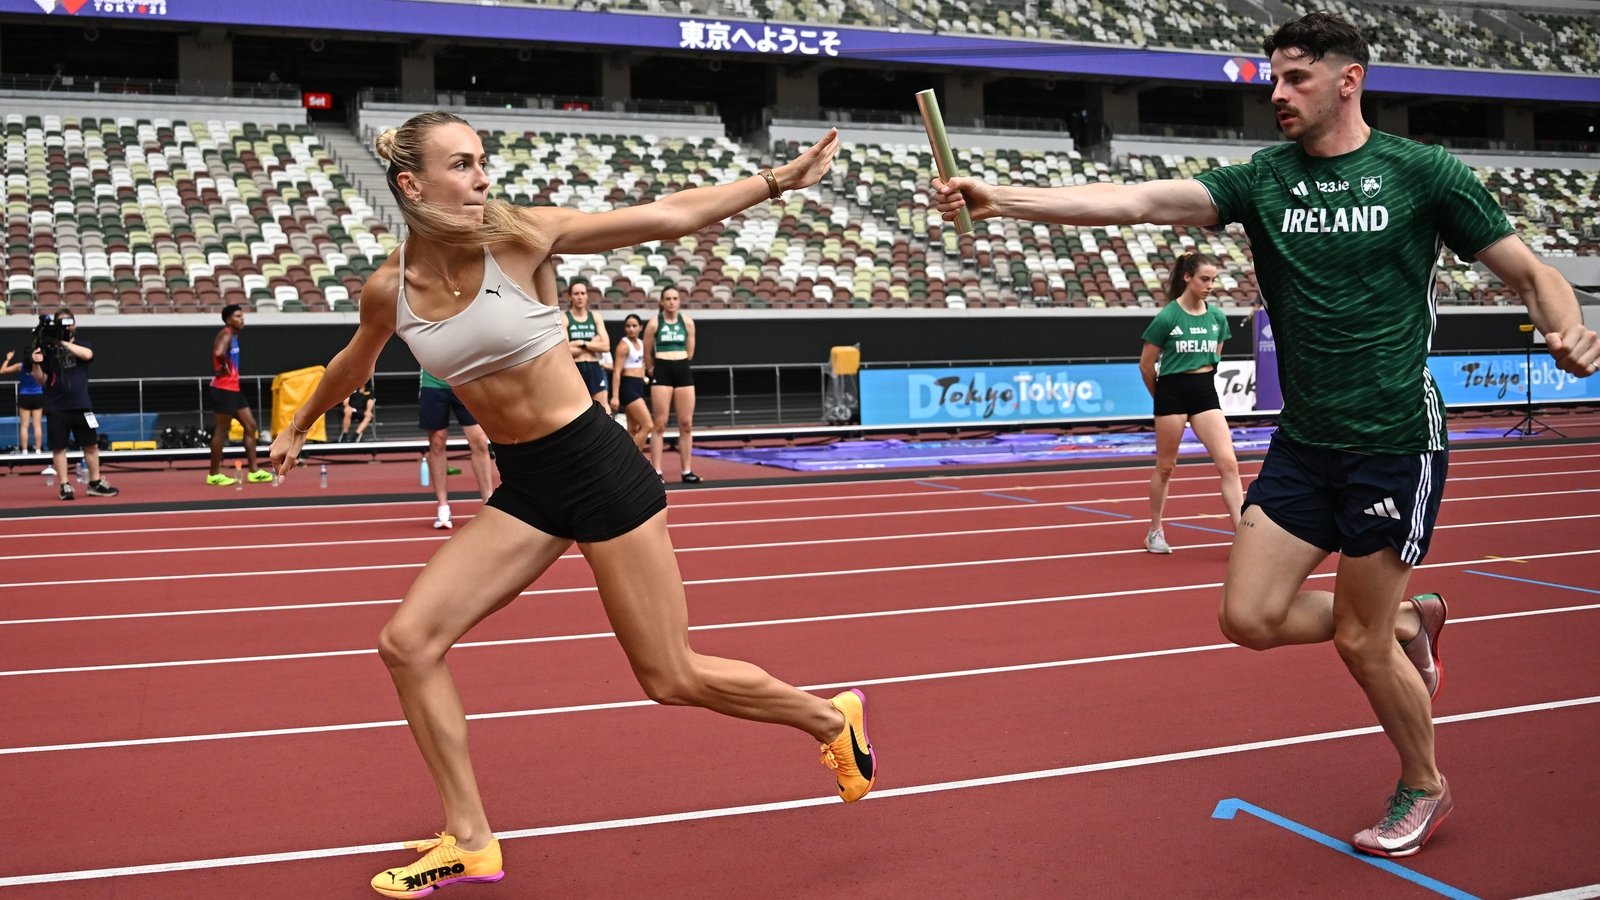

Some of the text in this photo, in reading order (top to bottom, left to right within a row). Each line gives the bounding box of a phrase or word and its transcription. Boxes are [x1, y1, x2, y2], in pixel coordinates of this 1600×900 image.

[679, 20, 841, 56] 東京へようこそ
[1281, 205, 1389, 233] IRELAND
[933, 375, 1093, 418] Tokyo Tokyo
[1218, 369, 1256, 396] Tok
[1461, 362, 1520, 399] Tokyo
[401, 863, 465, 891] NITRO
